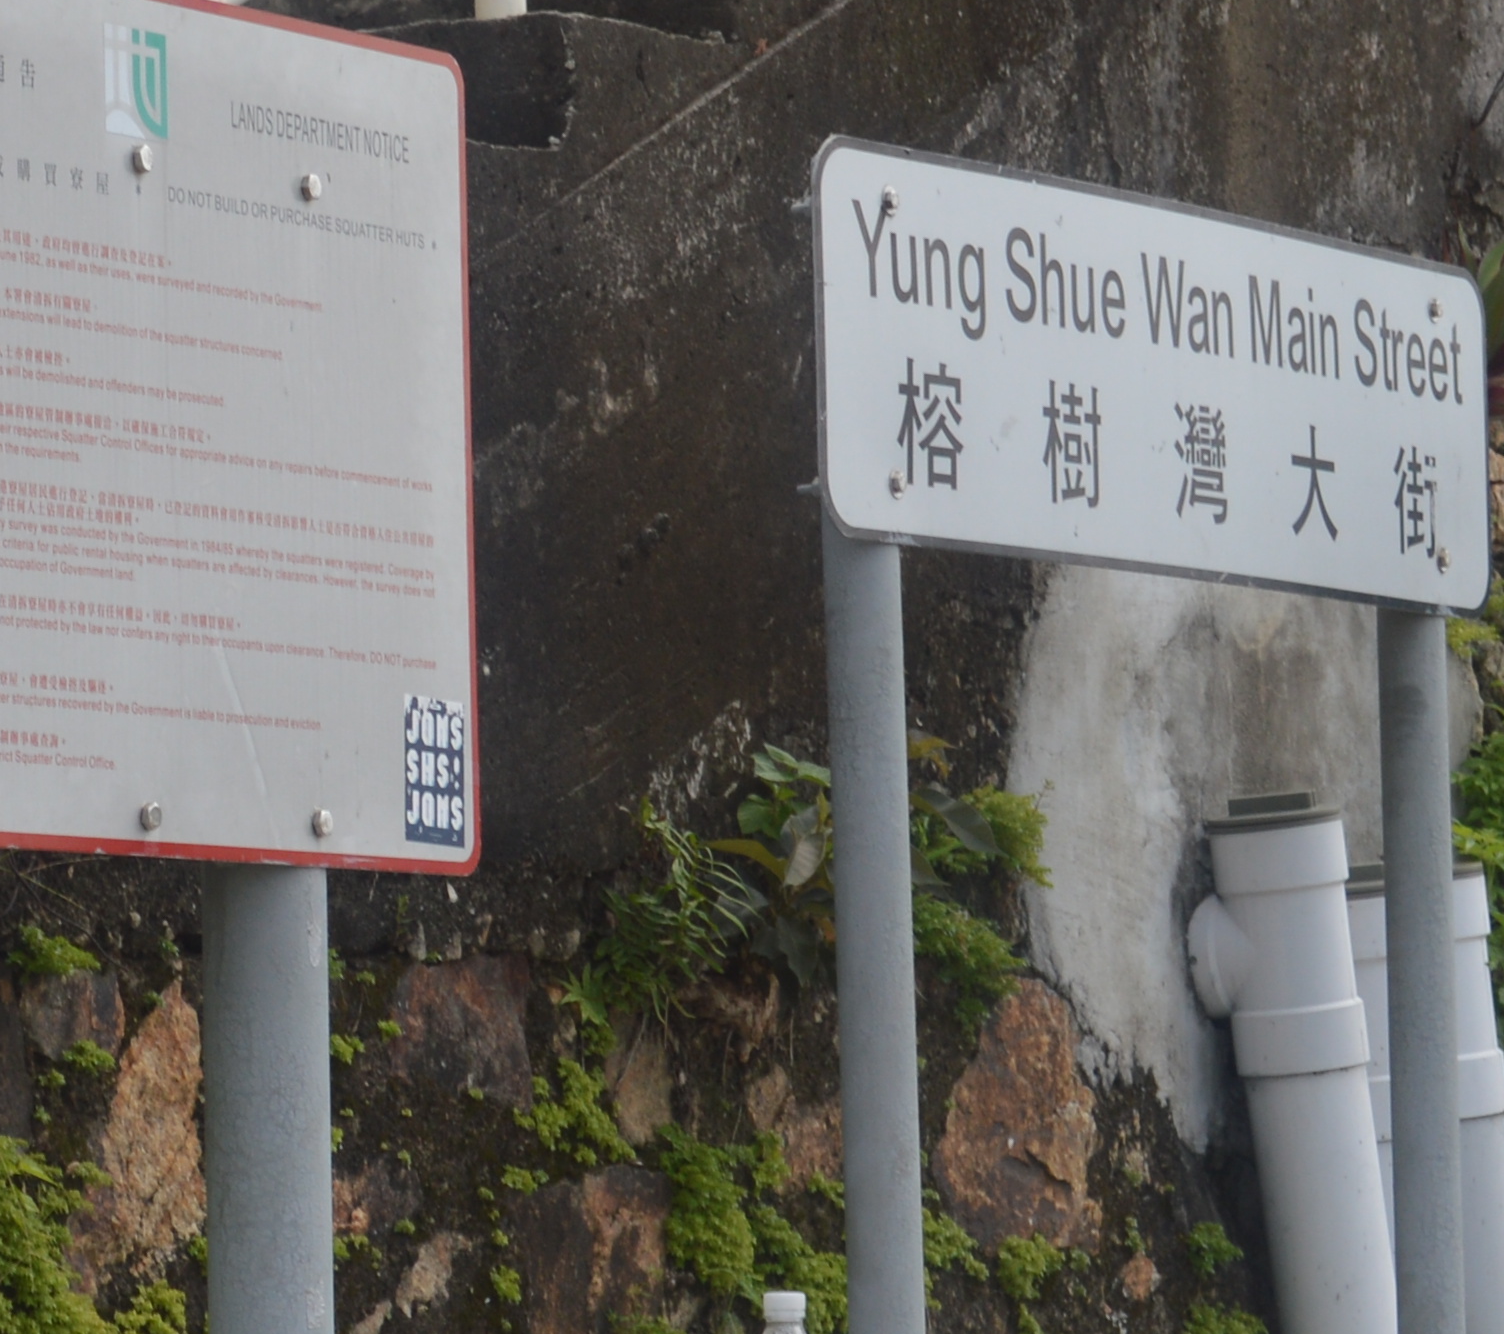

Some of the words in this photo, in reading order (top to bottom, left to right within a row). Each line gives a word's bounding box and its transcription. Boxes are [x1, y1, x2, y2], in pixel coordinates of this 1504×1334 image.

[230, 102, 273, 135] LANDS
[276, 111, 361, 154] DEPARTMENT
[364, 129, 408, 164] NOTICE
[168, 185, 185, 206] DO
[187, 189, 212, 211] NOT
[215, 194, 248, 217] BUILD
[251, 201, 267, 221] OR
[270, 204, 333, 232] PURCHASE
[335, 216, 393, 243] SQUATTER
[395, 227, 424, 249] HUTS
[850, 198, 986, 341] Yung
[1005, 226, 1126, 339] Shue
[1140, 251, 1235, 359] Wan
[1248, 273, 1340, 380] Main
[1353, 297, 1463, 405] Street
[4, 441, 19, 455] the
[896, 356, 1439, 561] 榕樹灣大街
[1, 536, 34, 552] criteria
[6, 520, 37, 535] survey
